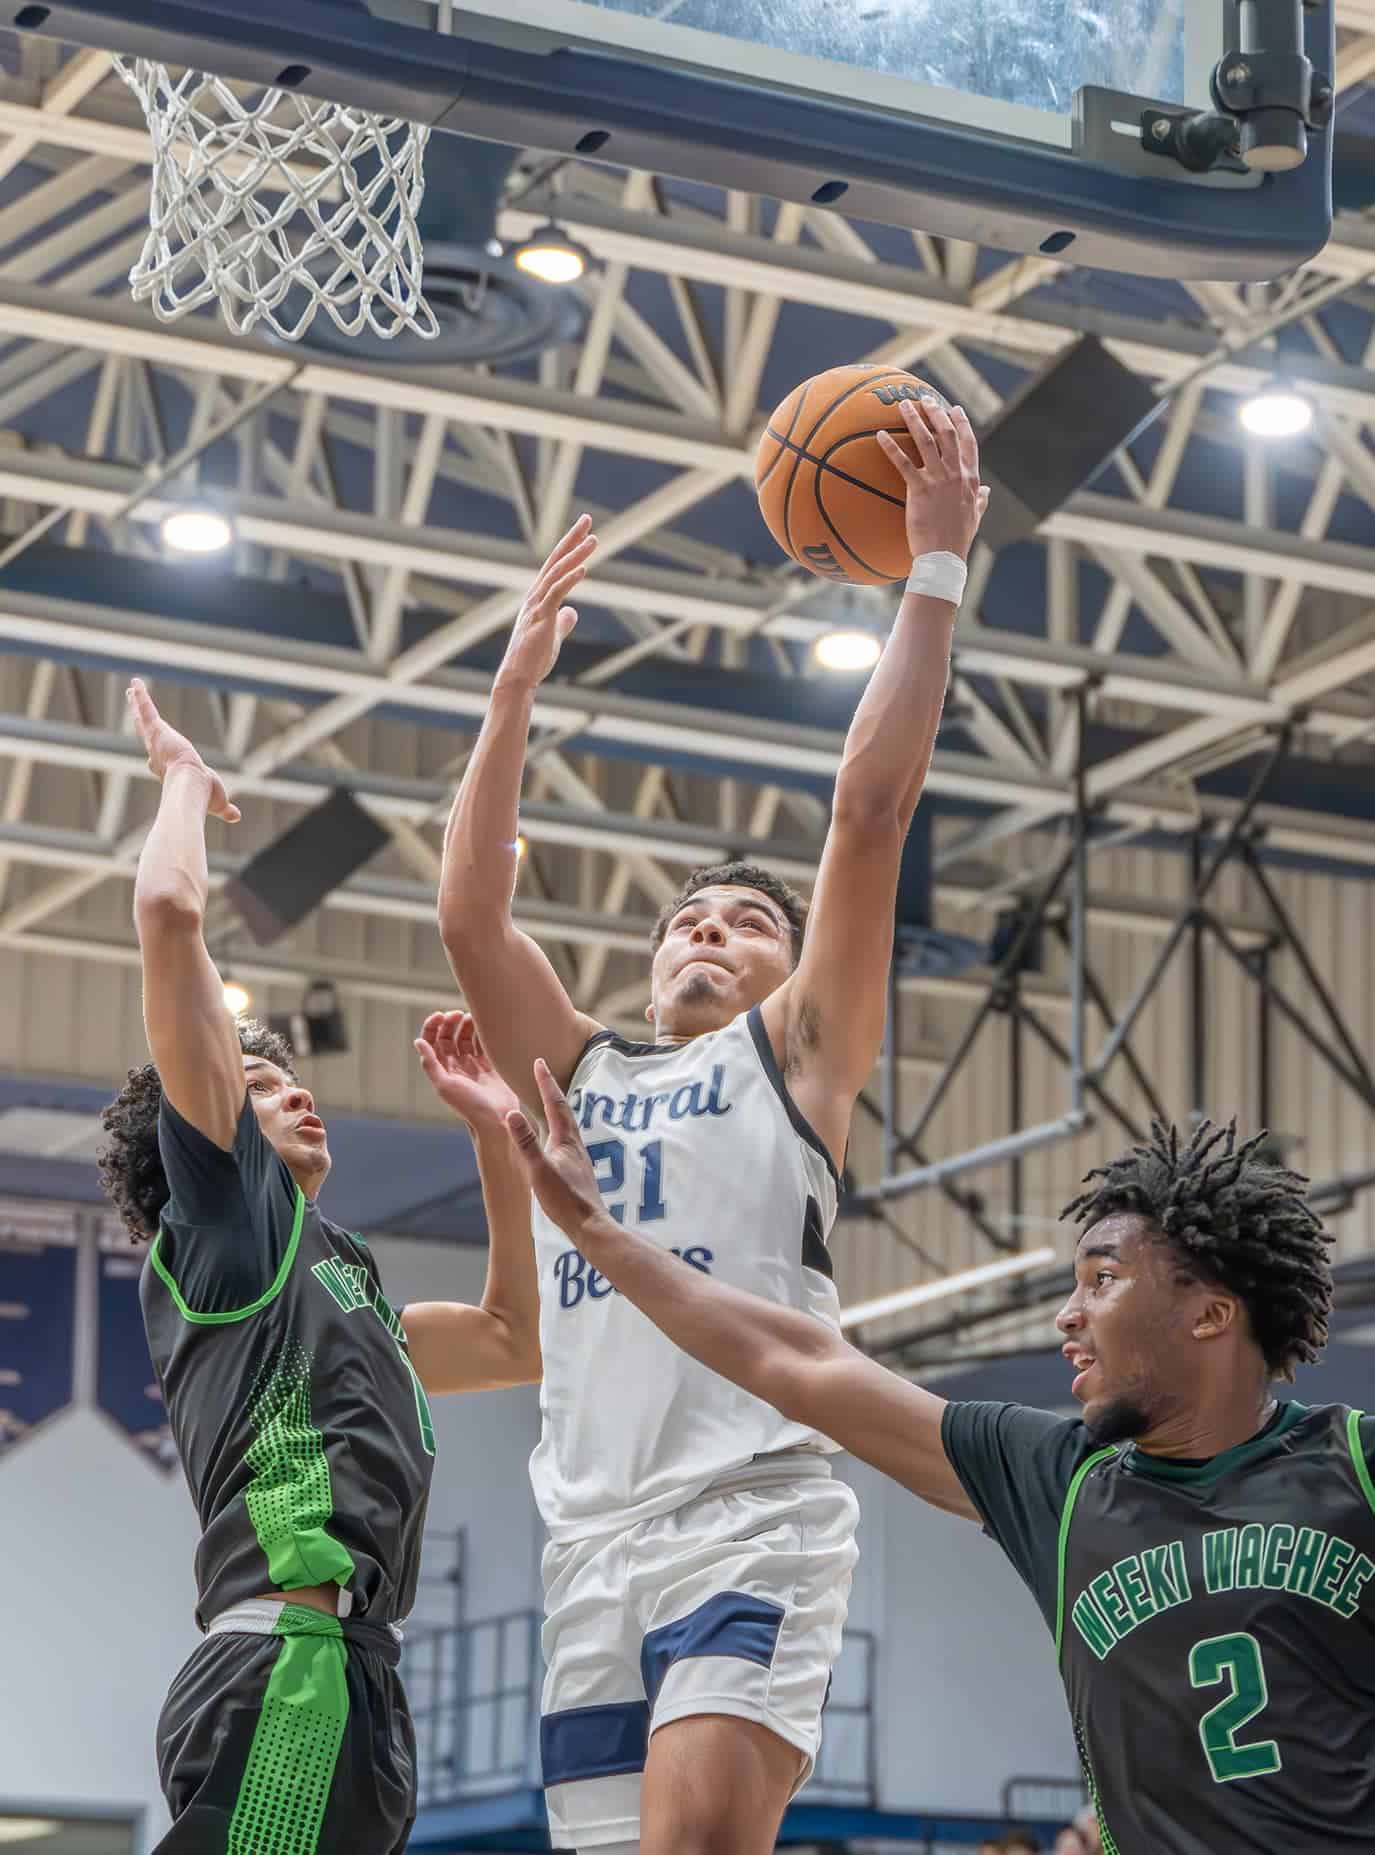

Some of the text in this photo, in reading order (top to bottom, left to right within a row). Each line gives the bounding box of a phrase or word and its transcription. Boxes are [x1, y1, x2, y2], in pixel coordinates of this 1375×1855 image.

[586, 1138, 667, 1225] 21
[1072, 1523, 1375, 1660] WEEKI WACHEE
[1188, 1631, 1282, 1783] 2
